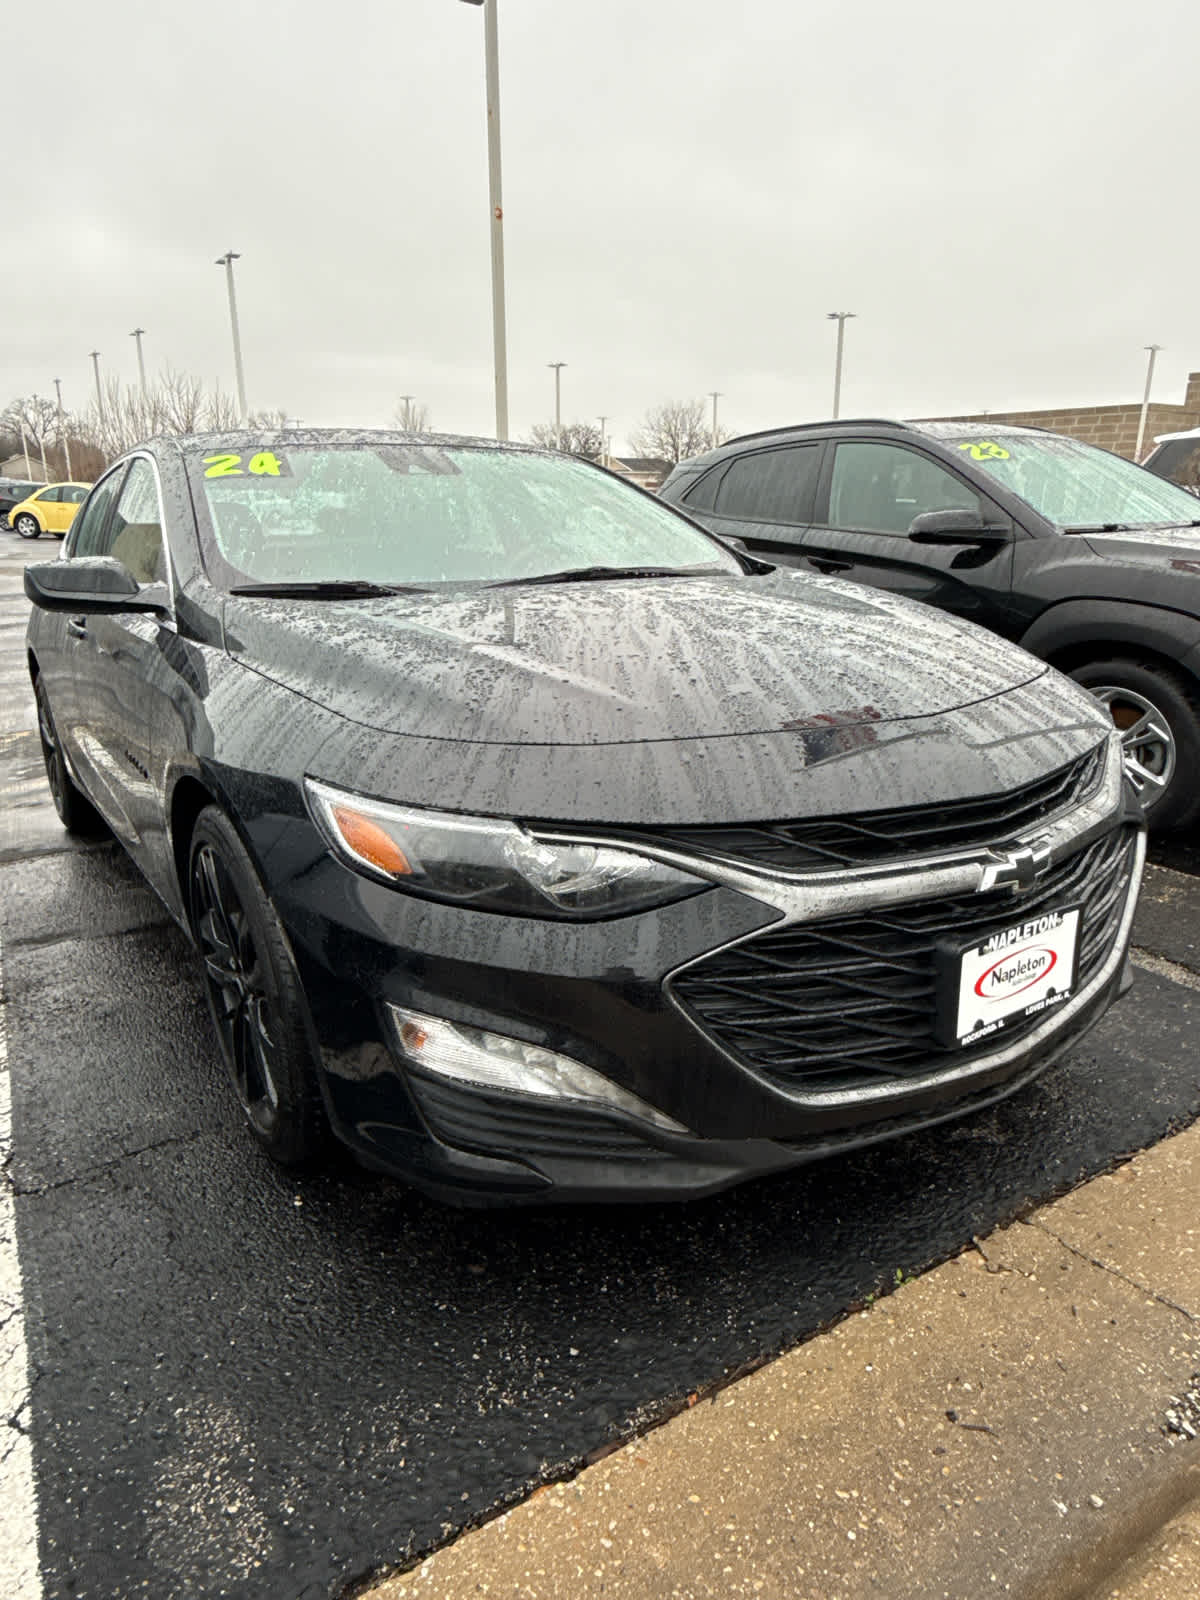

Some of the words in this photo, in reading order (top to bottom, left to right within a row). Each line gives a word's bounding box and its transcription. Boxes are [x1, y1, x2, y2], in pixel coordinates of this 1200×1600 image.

[202, 452, 282, 478] 24
[958, 442, 1009, 461] 23
[989, 913, 1058, 952] NAPLETON
[992, 956, 1046, 987] Napleton
